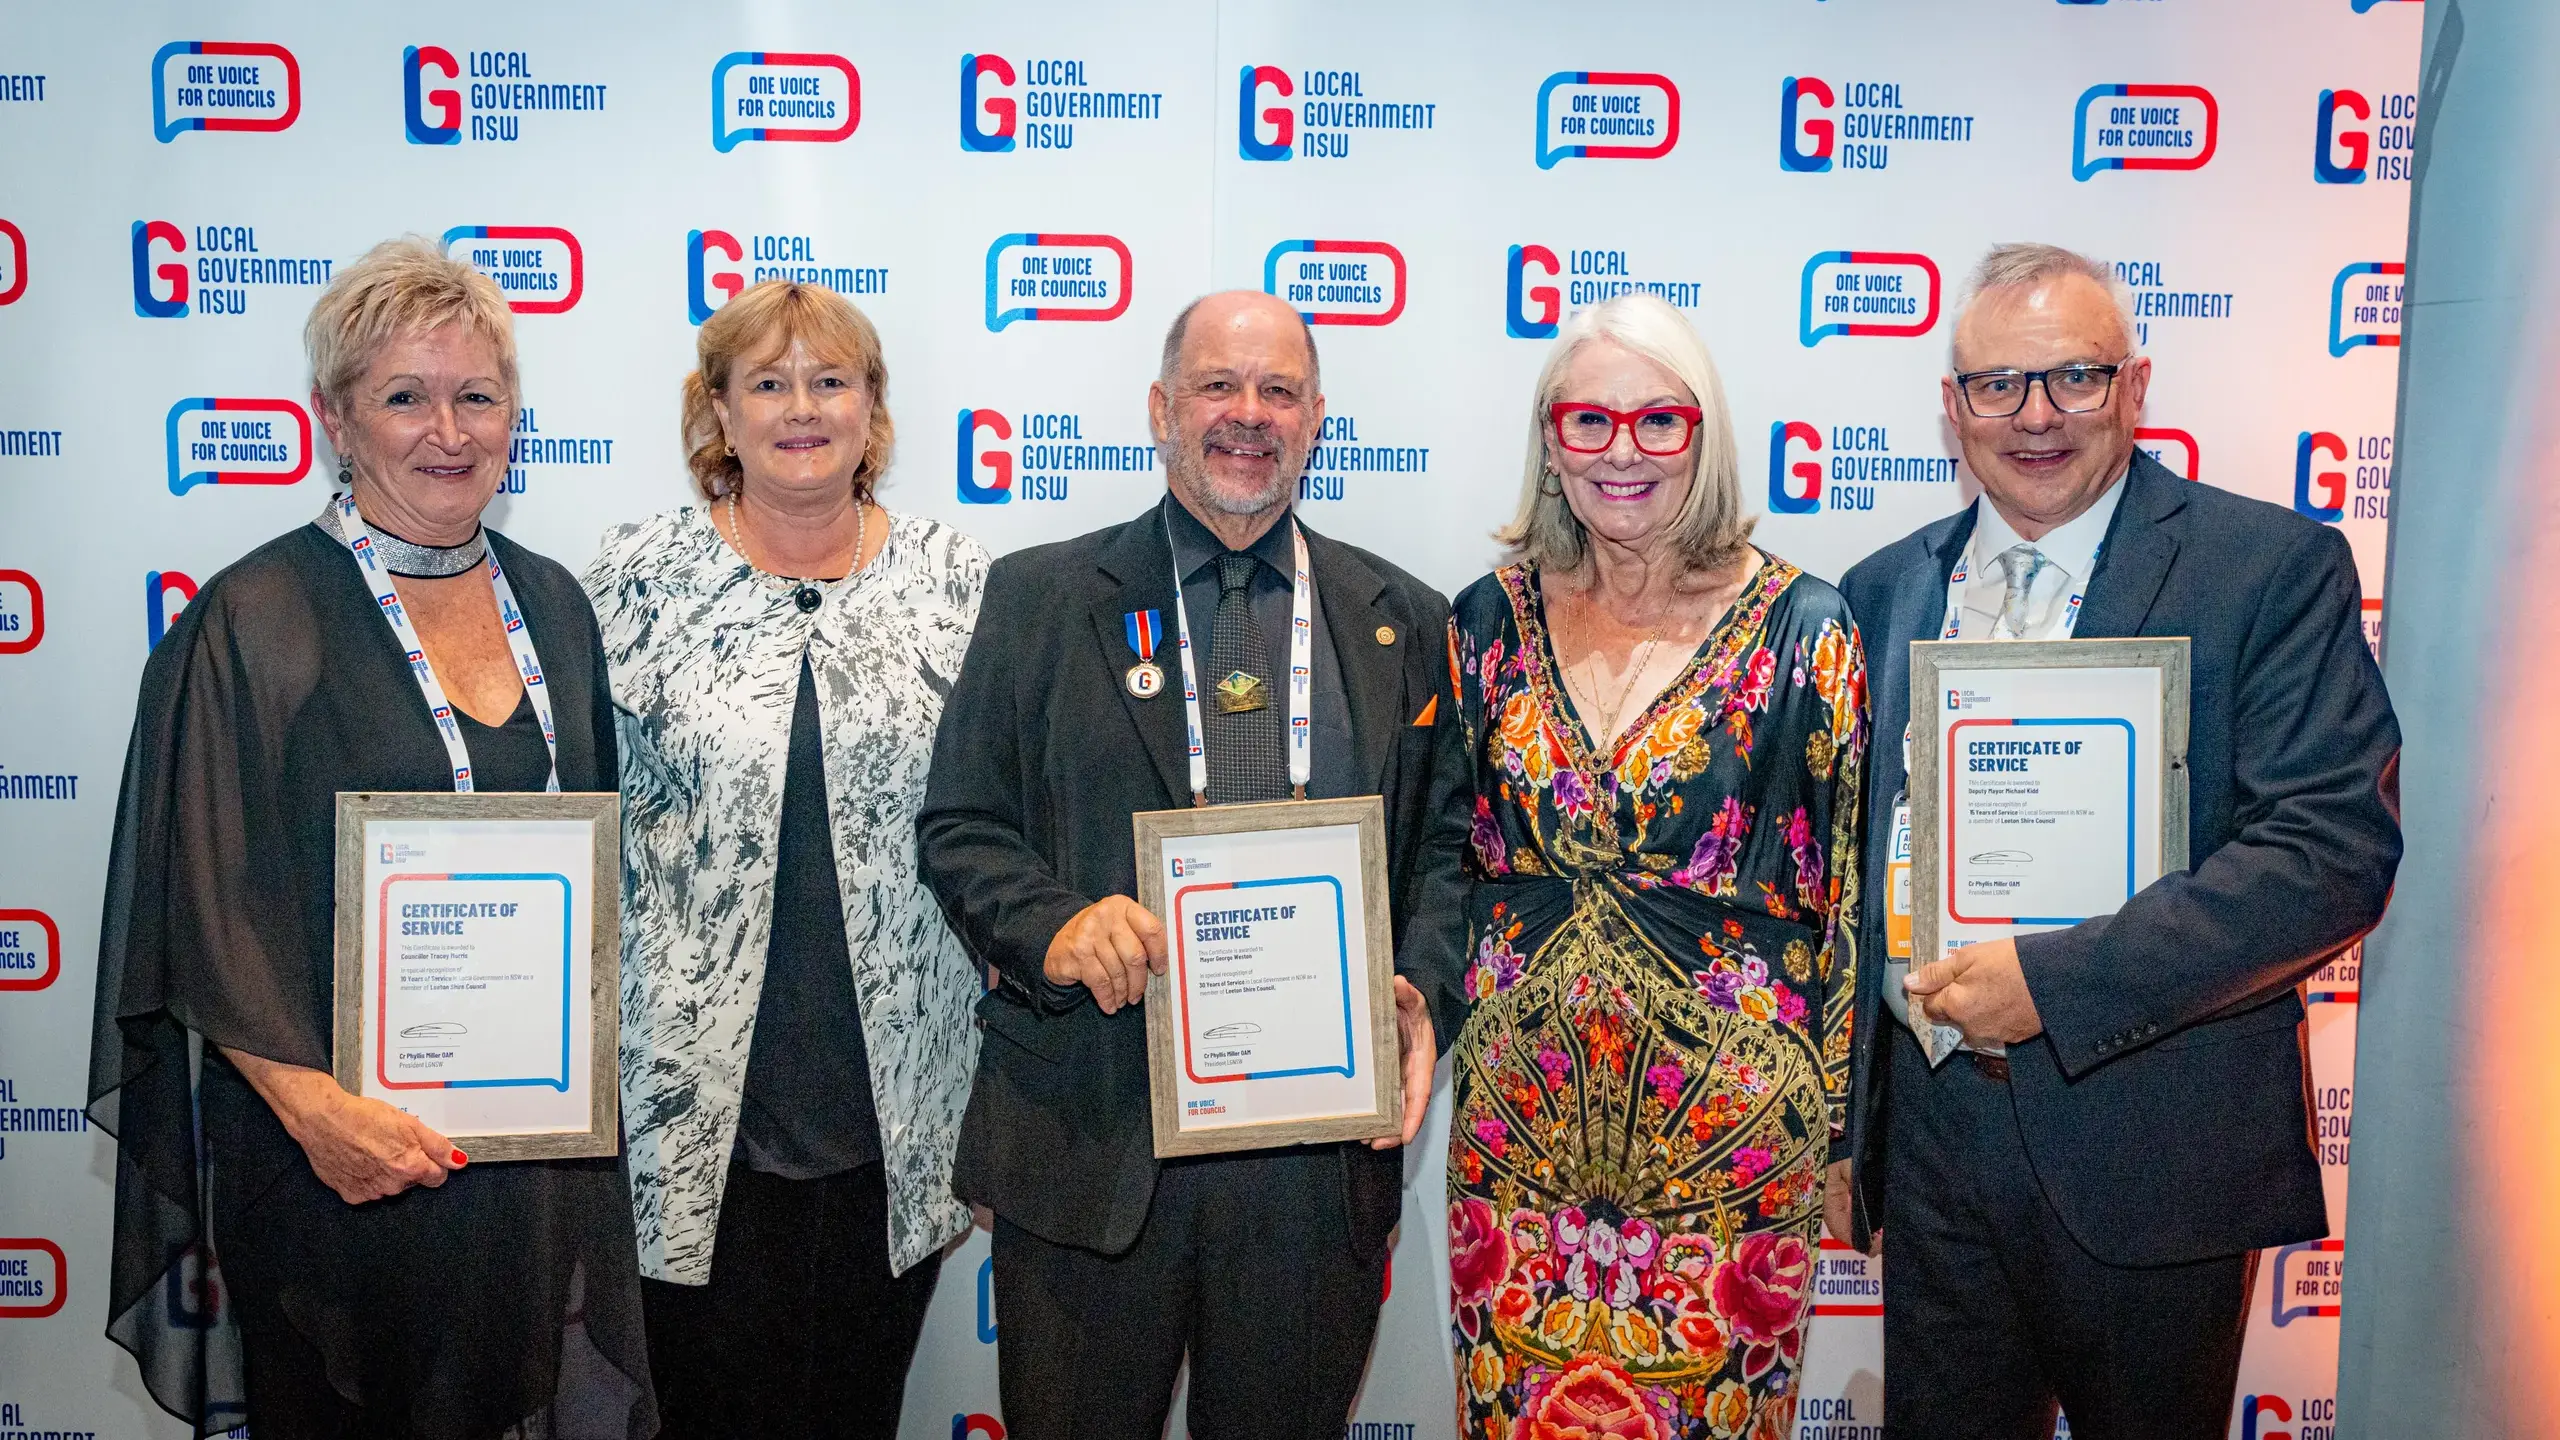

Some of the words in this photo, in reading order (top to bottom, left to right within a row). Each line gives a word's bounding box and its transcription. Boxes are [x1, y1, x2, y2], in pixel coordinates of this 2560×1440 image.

[471, 52, 531, 77] LOCAL
[1027, 60, 1087, 86] LOCAL
[188, 66, 213, 84] ONE
[218, 66, 259, 85] VOICE
[1305, 71, 1363, 96] LOCAL
[750, 77, 774, 94] ONE
[780, 78, 819, 95] VOICE
[1846, 83, 1902, 108] LOCAL
[178, 88, 203, 106] FOR
[208, 89, 275, 108] COUNCILS
[472, 84, 606, 110] GOVERNMENT
[1027, 92, 1162, 118] GOVERNMENT
[1573, 95, 1597, 112] ONE
[1602, 96, 1640, 113] VOICE
[739, 99, 763, 116] FOR
[769, 100, 834, 118] COUNCILS
[1305, 102, 1435, 128] GOVERNMENT
[2111, 107, 2136, 124] ONE
[2141, 108, 2179, 125] VOICE
[2381, 95, 2415, 119] LOC
[472, 116, 518, 141] NSW
[1562, 117, 1585, 134] FOR
[1591, 118, 1654, 135] COUNCILS
[1845, 114, 1973, 141] GOVERNMENT
[1027, 124, 1072, 148] NSW
[1304, 133, 1348, 157] NSW
[2099, 129, 2123, 146] FOR
[2129, 130, 2192, 147] COUNCILS
[1843, 144, 1887, 169] NSW
[197, 226, 258, 252] LOCAL
[754, 236, 814, 261] LOCAL
[473, 250, 498, 267] ONE
[503, 250, 542, 267] VOICE
[1023, 257, 1047, 274] ONE
[1053, 258, 1091, 275] VOICE
[1572, 251, 1628, 275] LOCAL
[198, 258, 332, 284] GOVERNMENT
[1300, 263, 1324, 280] ONE
[1330, 264, 1367, 281] VOICE
[1012, 280, 1035, 296] FOR
[1042, 280, 1106, 297] COUNCILS
[1837, 274, 1860, 291] ONE
[1866, 275, 1902, 292] VOICE
[199, 289, 245, 314] NSW
[1289, 285, 1312, 301] FOR
[1318, 285, 1381, 303] COUNCILS
[2366, 285, 2390, 301] ONE
[1825, 296, 1848, 312] FOR
[1854, 297, 1915, 314] COUNCILS
[2133, 293, 2232, 317] VERNMENT
[2354, 307, 2377, 323] FOR
[202, 421, 226, 439] ONE
[231, 422, 271, 439] VOICE
[1024, 415, 1082, 439] LOCAL
[1315, 417, 1357, 441] CAL
[1833, 427, 1889, 451] LOCAL
[2358, 437, 2391, 460] LOC
[192, 443, 216, 460] FOR
[221, 444, 287, 461] COUNCILS
[509, 438, 613, 463] VERNMENT
[1023, 445, 1156, 471] GOVERNMENT
[1832, 457, 1958, 483] GOVERNMENT
[1023, 476, 1067, 500] NSW
[1300, 476, 1343, 500] NSW
[1831, 487, 1873, 510] NSW
[1969, 741, 2060, 755] CERTIFICATE
[2065, 741, 2082, 754] OF
[1969, 758, 2028, 772] SERVICE
[402, 903, 497, 918] CERTIFICATE
[500, 903, 518, 917] OF
[1195, 907, 1278, 925] CERTIFICATE
[1281, 906, 1296, 919] OF
[402, 921, 464, 935] SERVICE
[1196, 925, 1250, 942] SERVICE
[1947, 940, 1959, 948] ONE
[1210, 1051, 1226, 1059] Phyllis
[1188, 1100, 1198, 1108] ONE
[1200, 1099, 1215, 1107] VOICE
[2318, 1088, 2350, 1110] LOC
[1188, 1108, 1198, 1116] FOR
[1200, 1106, 1226, 1115] COUNCILS
[0, 1260, 28, 1276] OICE
[1830, 1260, 1867, 1276] VOICE
[2307, 1261, 2330, 1276] ONE
[1819, 1279, 1880, 1296] COUNCILS
[2296, 1281, 2319, 1296] FOR
[1800, 1399, 1855, 1421] LOCAL
[2302, 1399, 2333, 1421] LOC
